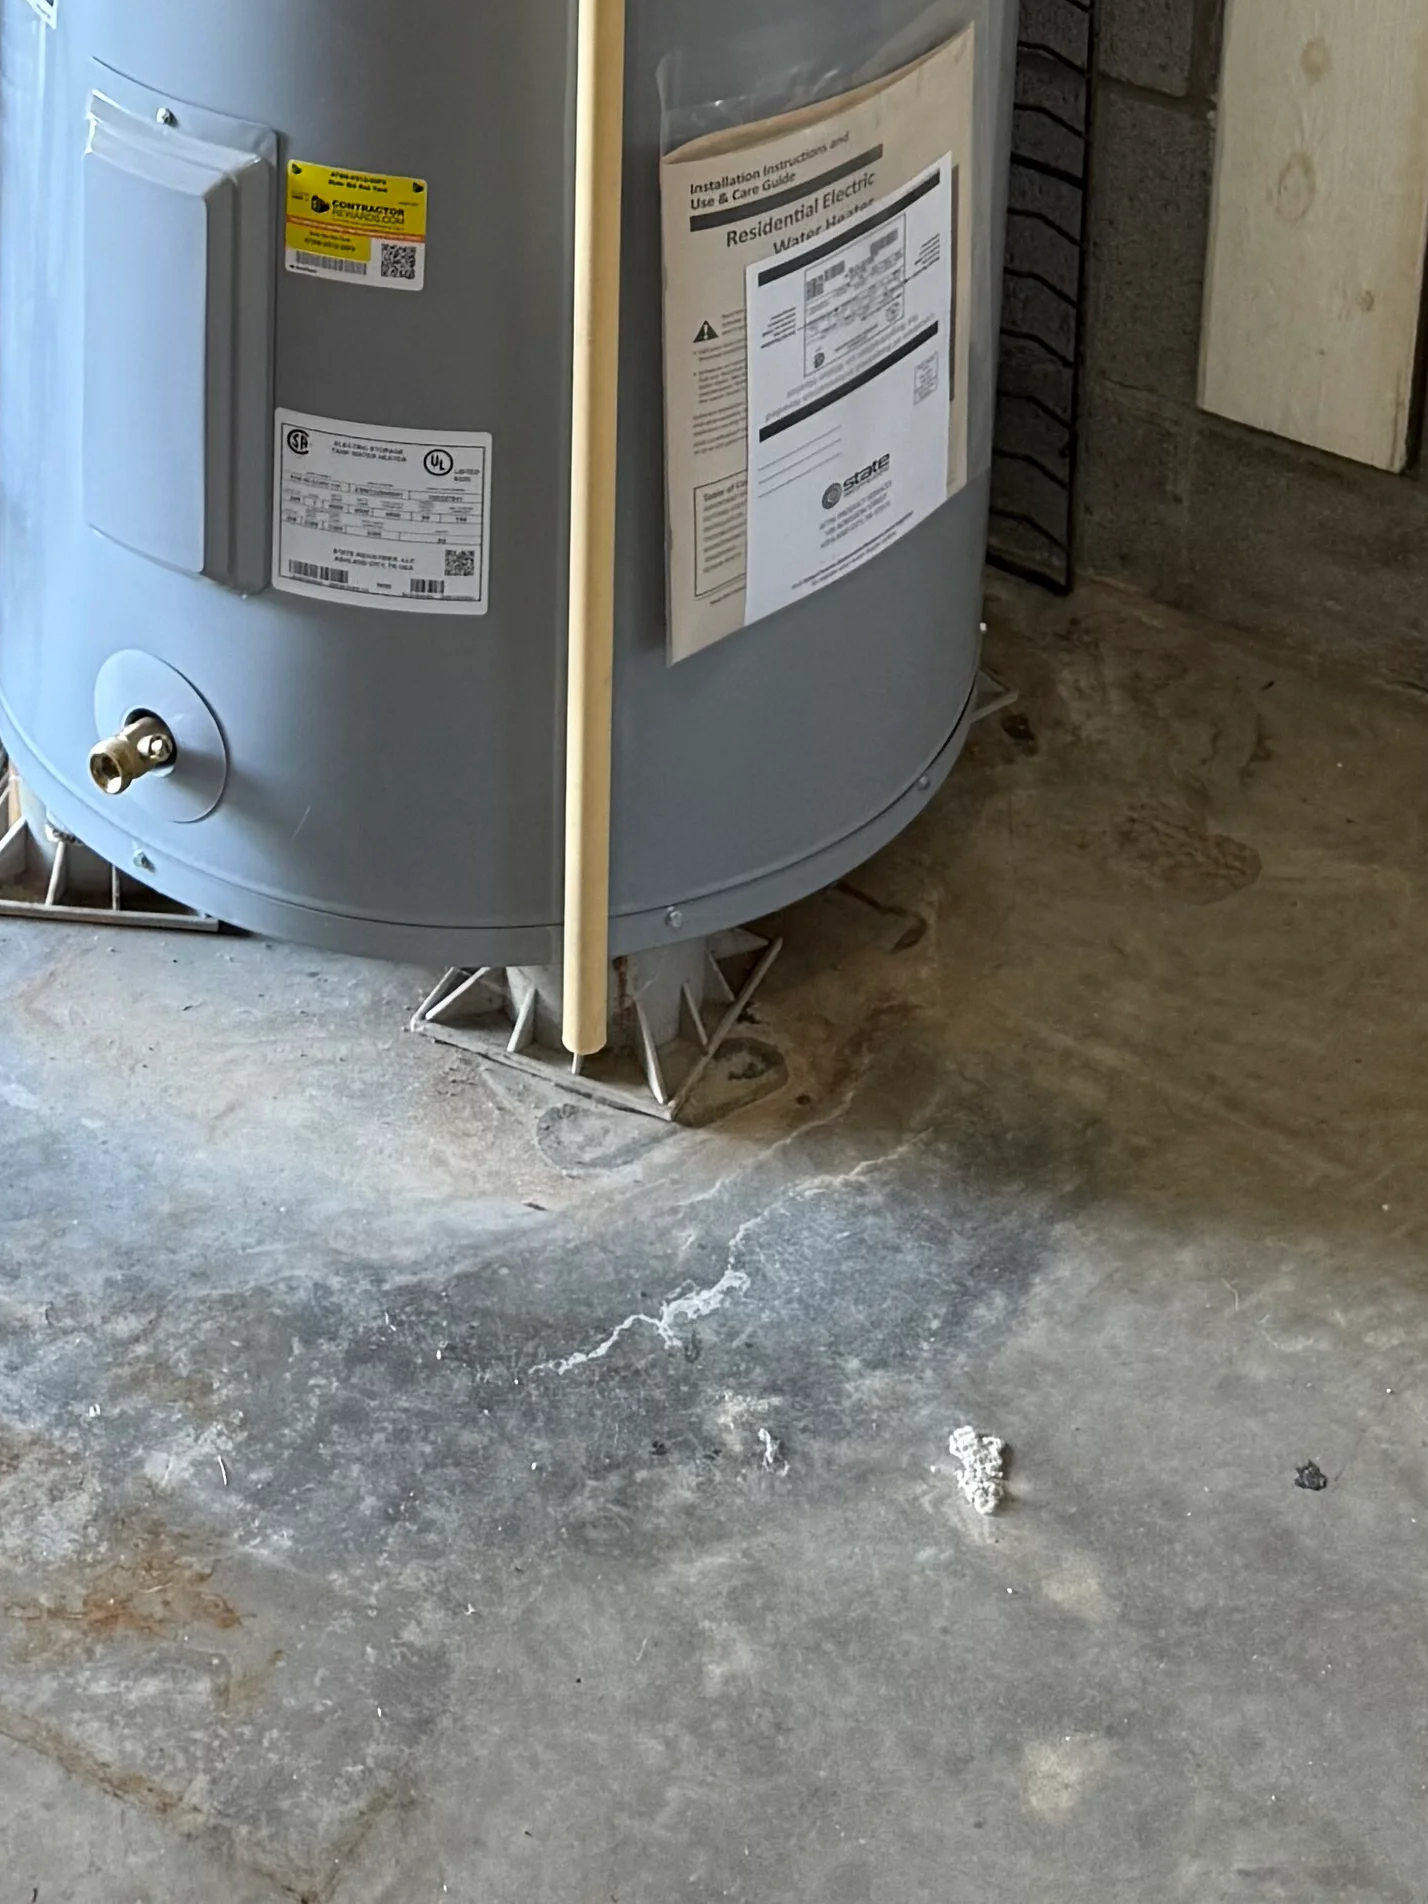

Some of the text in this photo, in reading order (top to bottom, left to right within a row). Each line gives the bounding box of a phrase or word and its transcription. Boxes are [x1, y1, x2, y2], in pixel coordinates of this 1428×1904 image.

[690, 131, 850, 195] Installation Instructions and
[332, 200, 404, 216] CONTRACTOR
[690, 171, 796, 210] Use & Care Guide
[727, 171, 875, 248] Residential Electric
[772, 226, 822, 254] Water
[431, 454, 445, 471] UL
[843, 453, 891, 492] state
